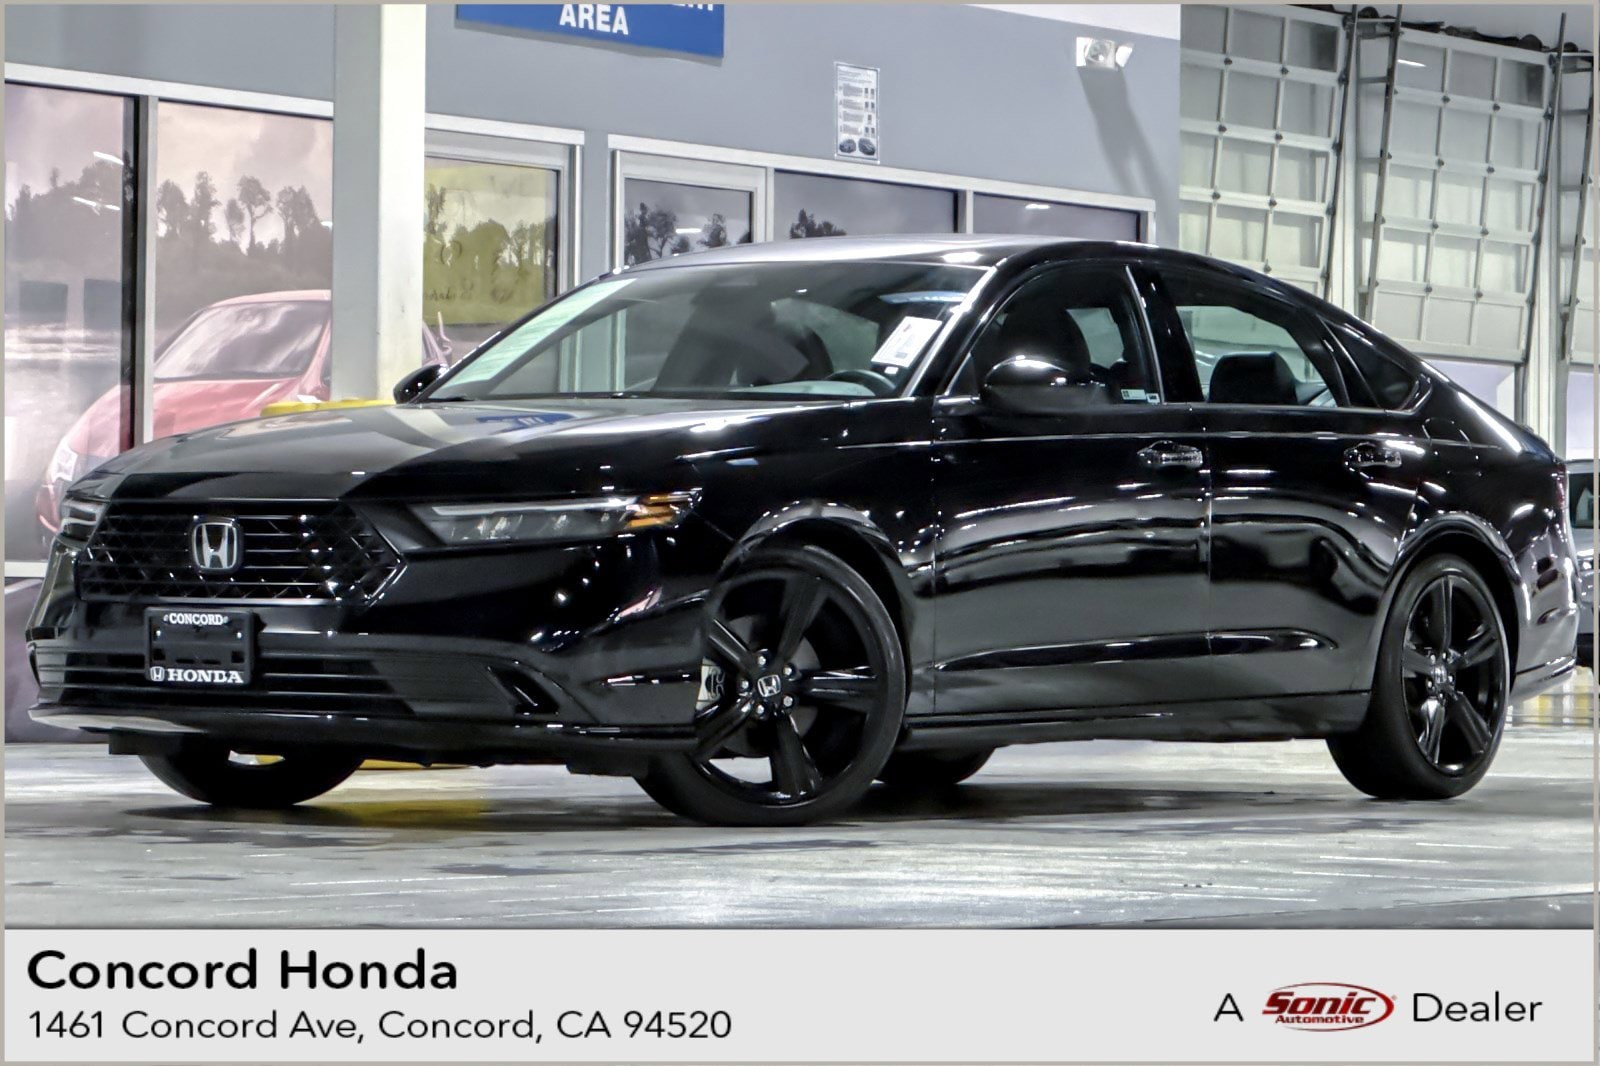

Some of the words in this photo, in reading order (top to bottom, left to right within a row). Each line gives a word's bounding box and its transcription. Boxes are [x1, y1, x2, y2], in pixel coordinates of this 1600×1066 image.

[559, 4, 629, 35] AREA
[168, 612, 224, 626] CONCORD
[168, 667, 244, 684] HONDA
